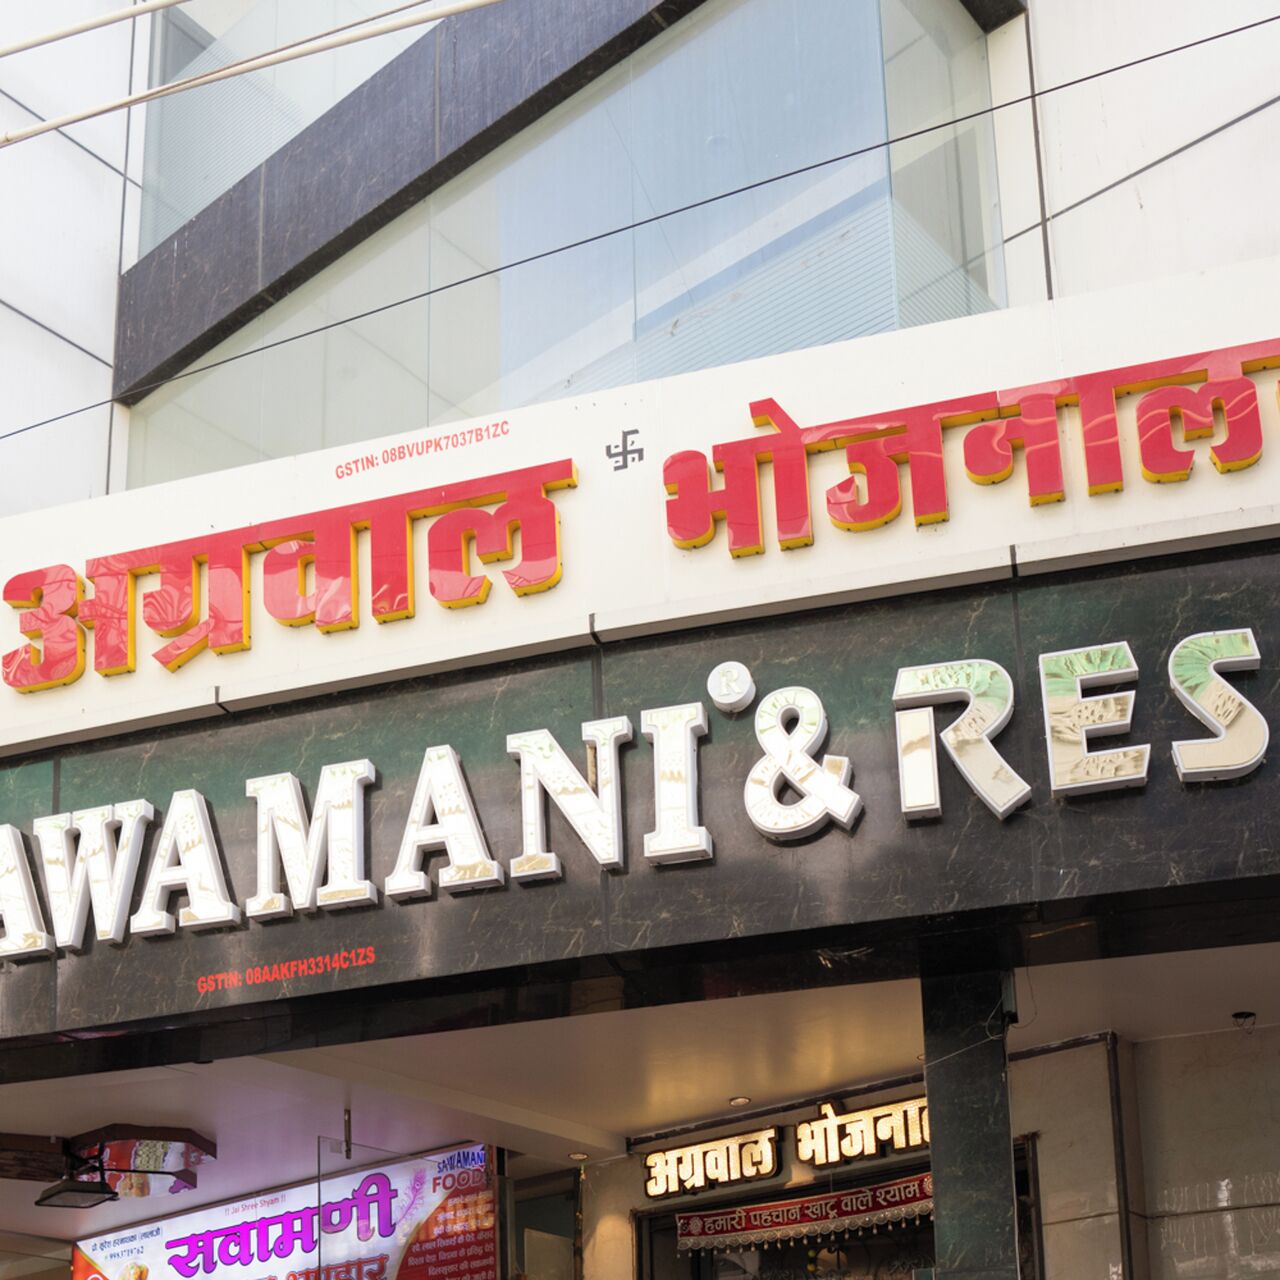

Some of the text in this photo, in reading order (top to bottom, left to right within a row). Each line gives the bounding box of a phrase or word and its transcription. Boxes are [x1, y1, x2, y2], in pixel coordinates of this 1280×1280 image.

[335, 421, 510, 480] GSTIN: 08BVUPK7037B1ZC
[2, 459, 579, 694] अग्रवाल
[743, 686, 863, 842] &
[196, 974, 243, 994] GSTIN:
[645, 1126, 778, 1197] अग्रवाल
[165, 1172, 398, 1278] सवामणी
[704, 1211, 745, 1236] हमारी
[804, 1197, 838, 1220] खाटू
[841, 1189, 873, 1213] वाले
[876, 1181, 921, 1206] श्याम
